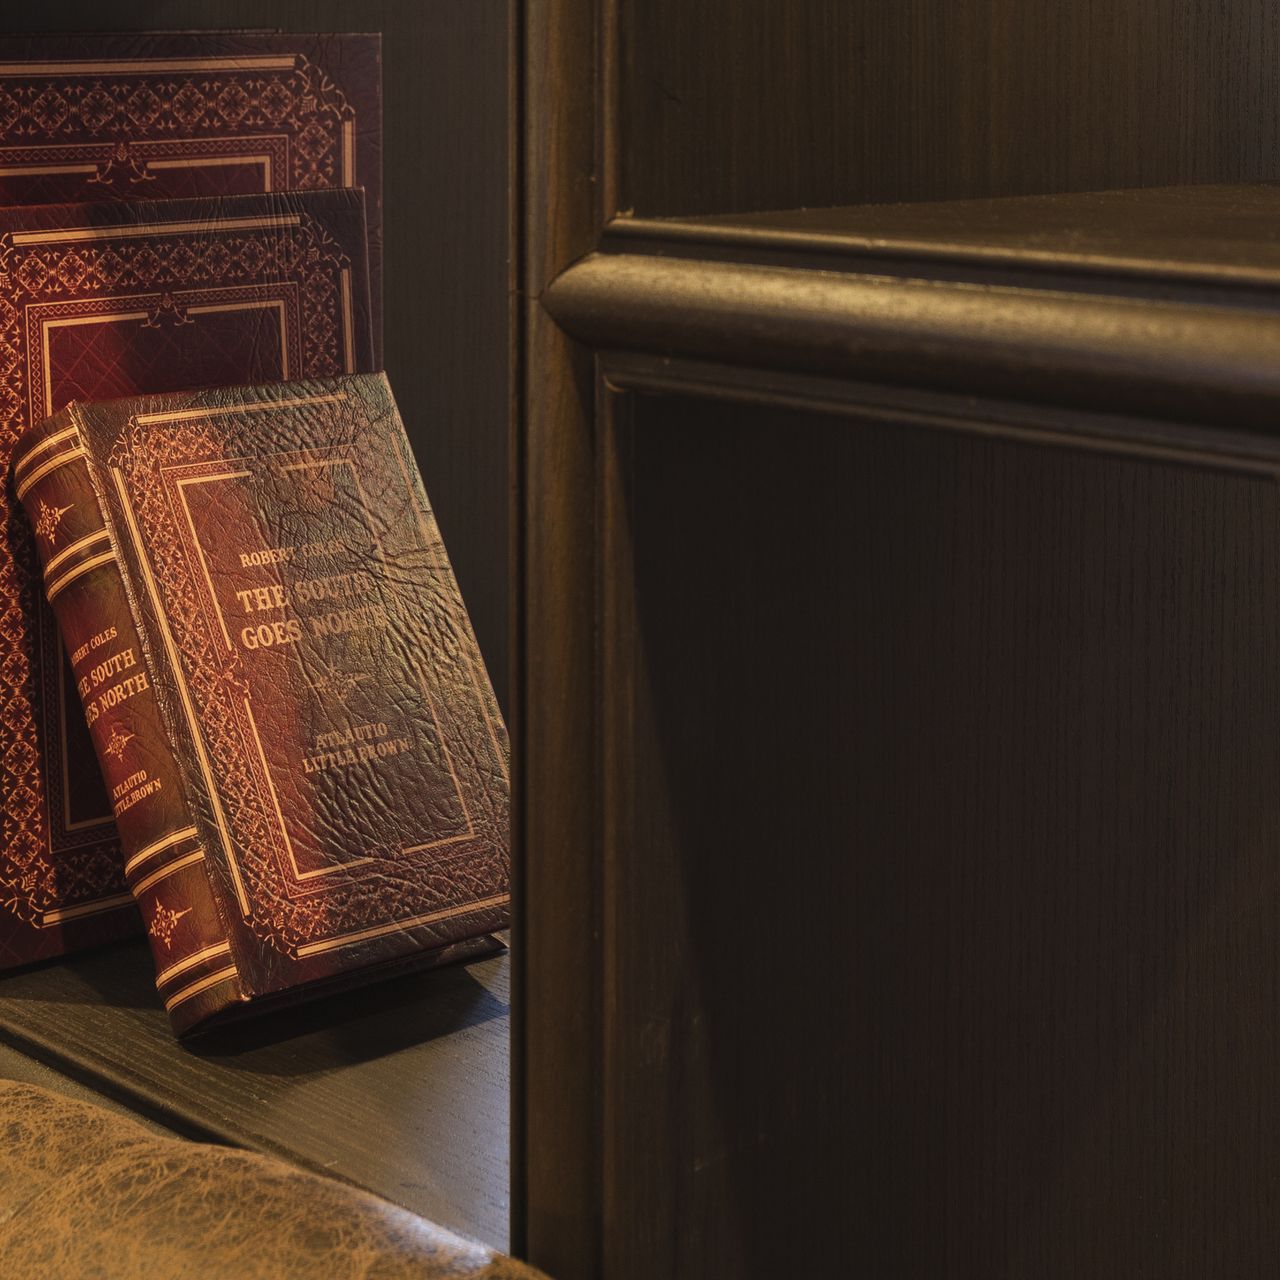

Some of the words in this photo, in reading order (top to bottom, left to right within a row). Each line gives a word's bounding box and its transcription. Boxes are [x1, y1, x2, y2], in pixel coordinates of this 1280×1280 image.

[239, 546, 296, 568] ROBERT
[236, 585, 289, 613] THE
[295, 571, 371, 603] SOUTH
[90, 626, 118, 649] COLES
[241, 620, 303, 650] GOES
[308, 604, 388, 638] NORTH
[90, 647, 137, 687] SOUTH
[99, 671, 150, 713] NORTH
